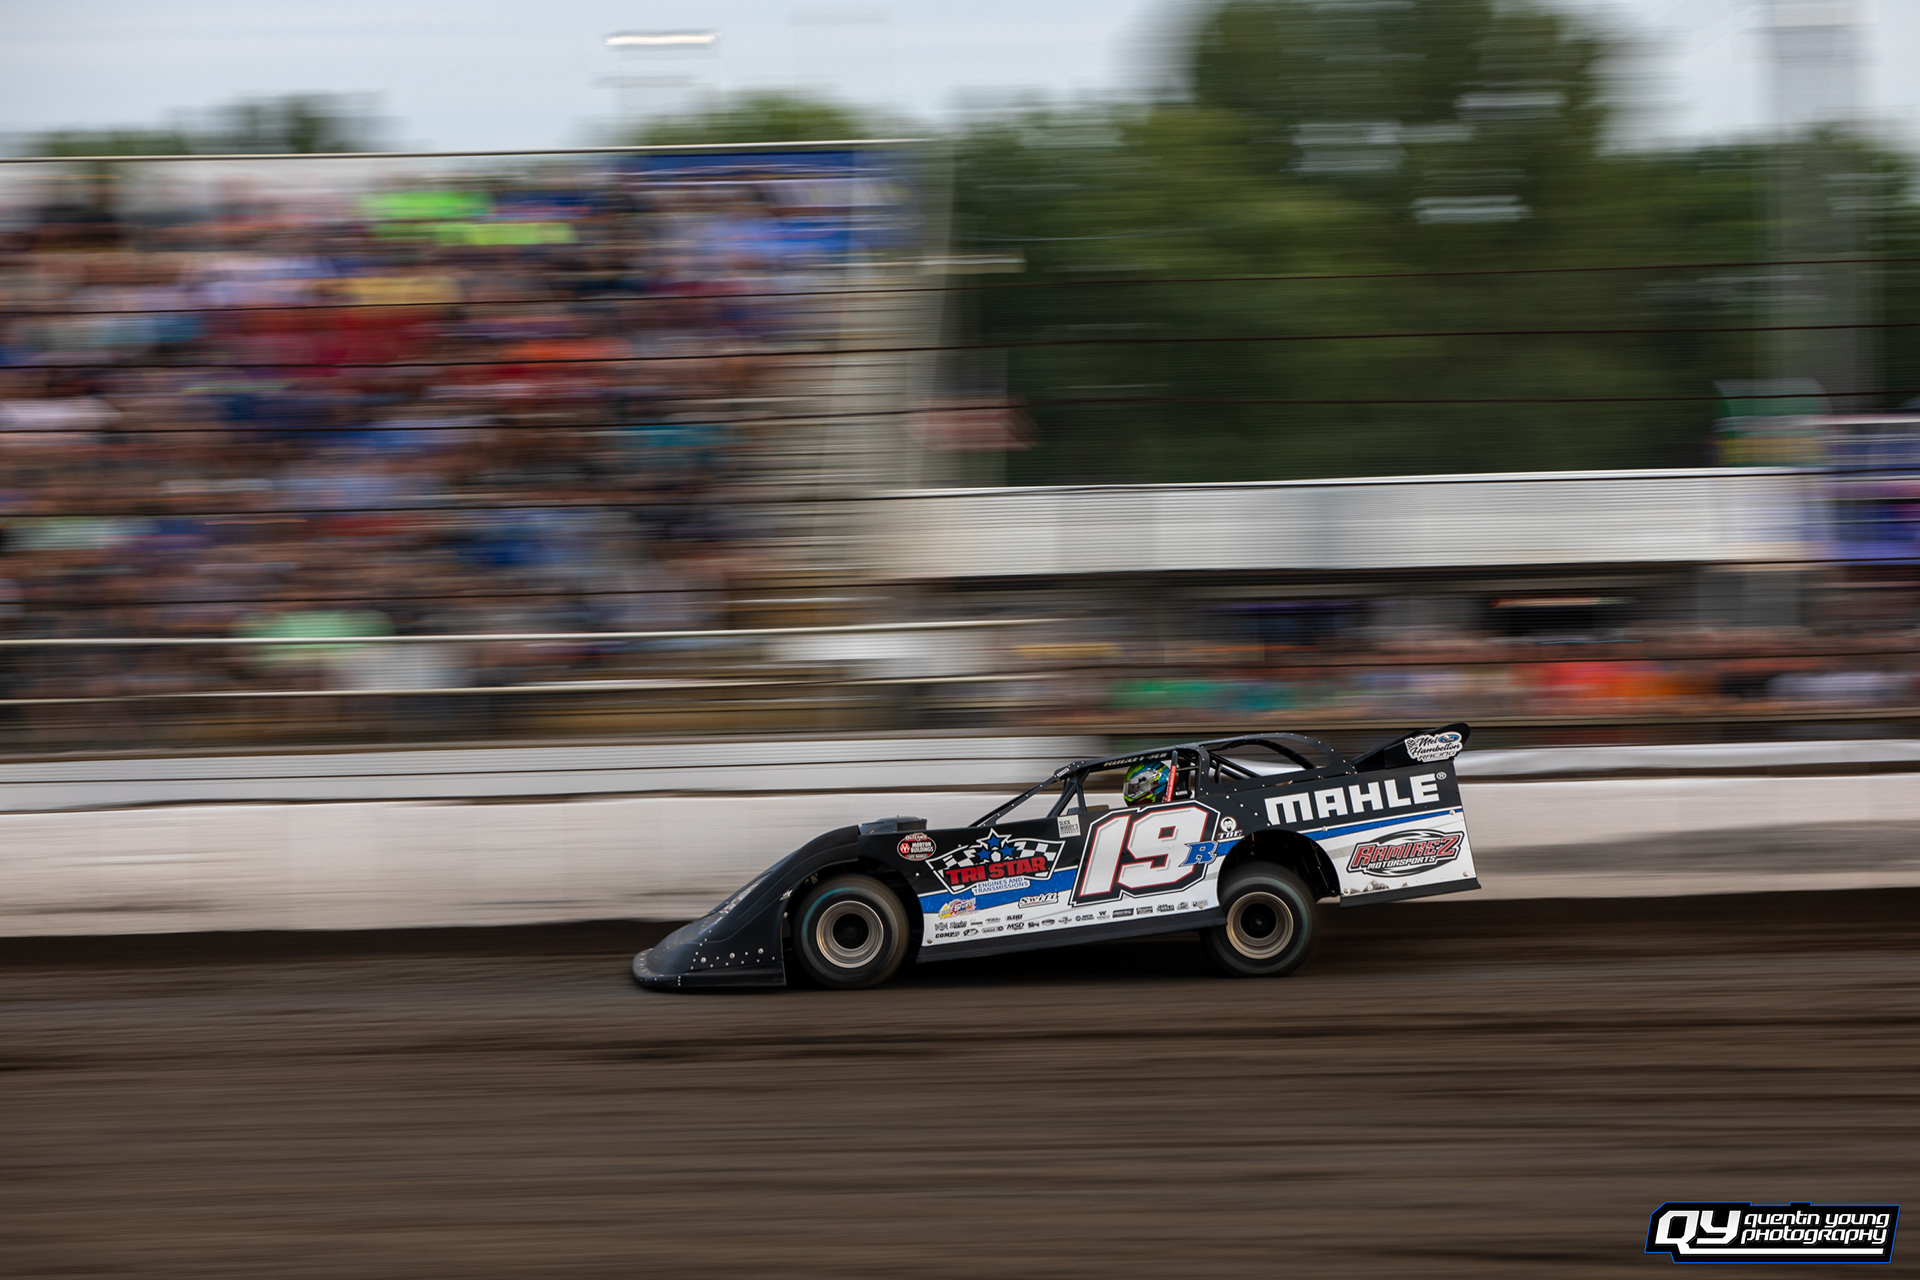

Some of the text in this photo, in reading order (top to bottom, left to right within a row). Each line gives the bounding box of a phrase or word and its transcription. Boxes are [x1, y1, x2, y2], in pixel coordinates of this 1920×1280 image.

[1264, 773, 1440, 826] MAHLE
[1078, 805, 1218, 898] 19 R
[1351, 835, 1460, 867] RAMIREZ
[1367, 855, 1437, 870] MOTORSPORTS
[946, 856, 1047, 885] TRI STAR
[977, 877, 1023, 888] ENGINES AND
[974, 881, 1029, 894] TRANSMISSIONS
